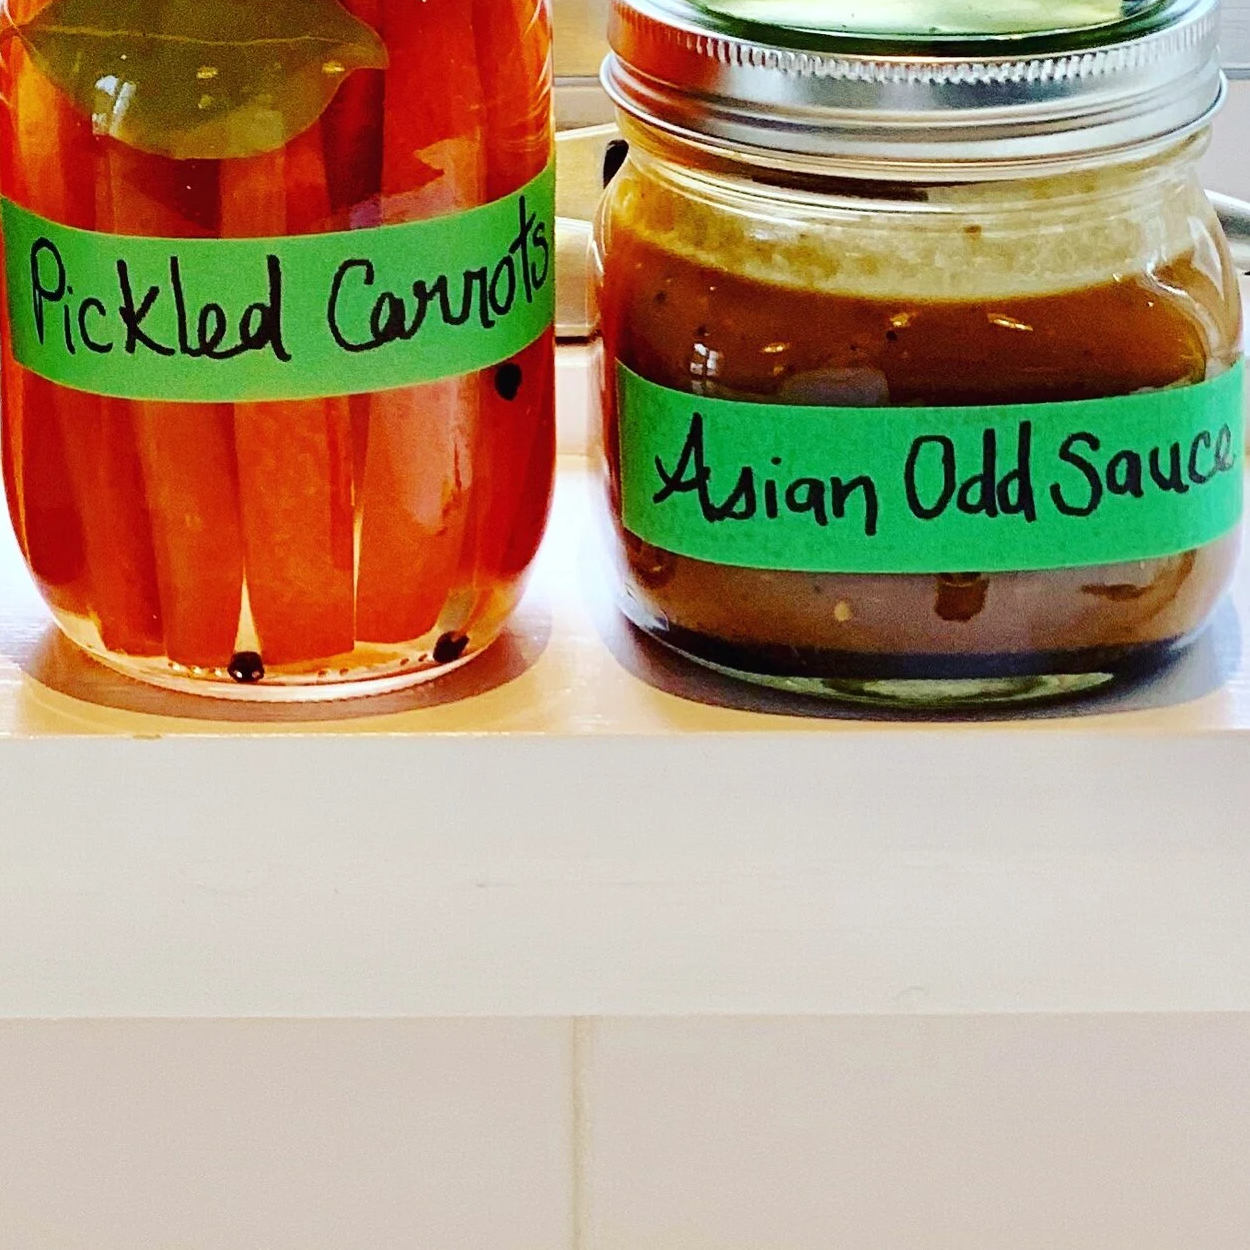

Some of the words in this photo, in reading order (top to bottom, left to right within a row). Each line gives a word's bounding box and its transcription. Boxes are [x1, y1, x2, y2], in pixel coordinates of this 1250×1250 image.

[30, 236, 292, 363] Pickled
[327, 194, 549, 353] Carrots
[654, 412, 878, 537] Asian
[903, 420, 1036, 523] Odd
[1050, 422, 1236, 518] Sauce
